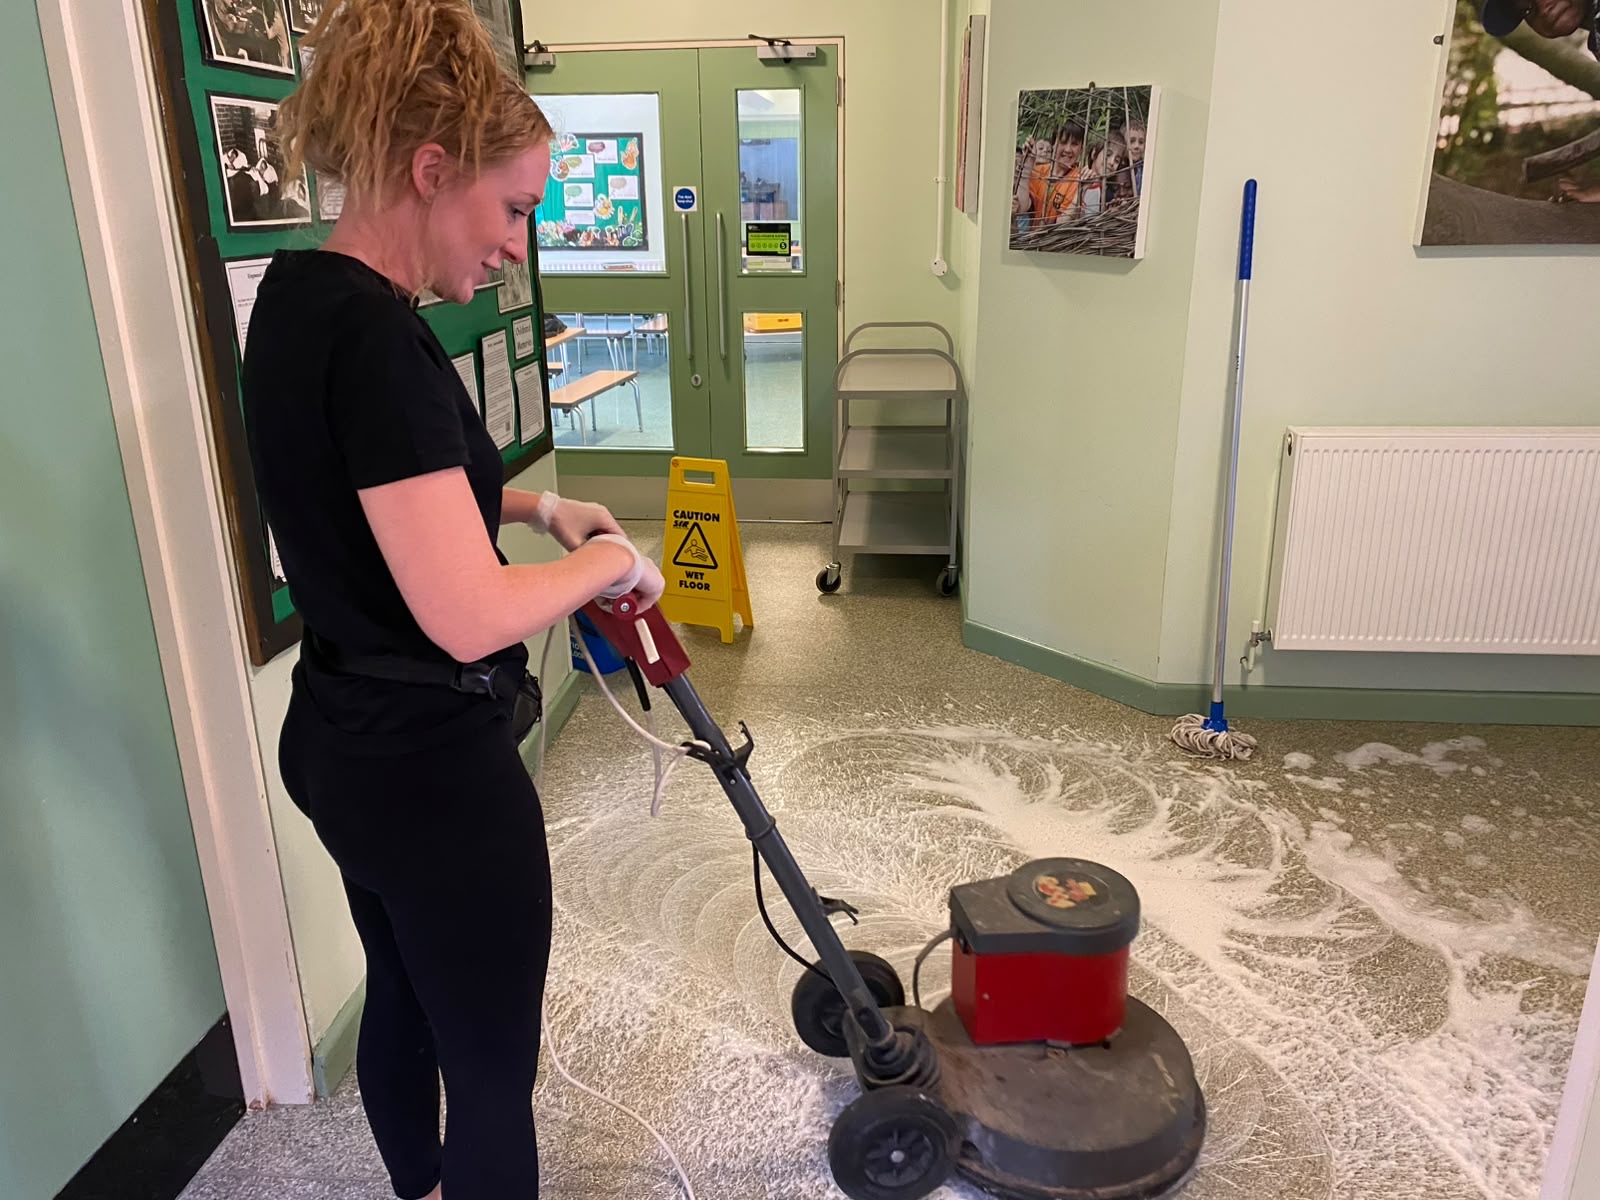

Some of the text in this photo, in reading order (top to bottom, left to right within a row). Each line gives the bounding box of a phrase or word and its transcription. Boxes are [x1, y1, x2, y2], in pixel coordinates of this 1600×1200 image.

[673, 509, 720, 523] CAUTION
[685, 570, 705, 581] WET
[679, 579, 711, 592] FLOOR
